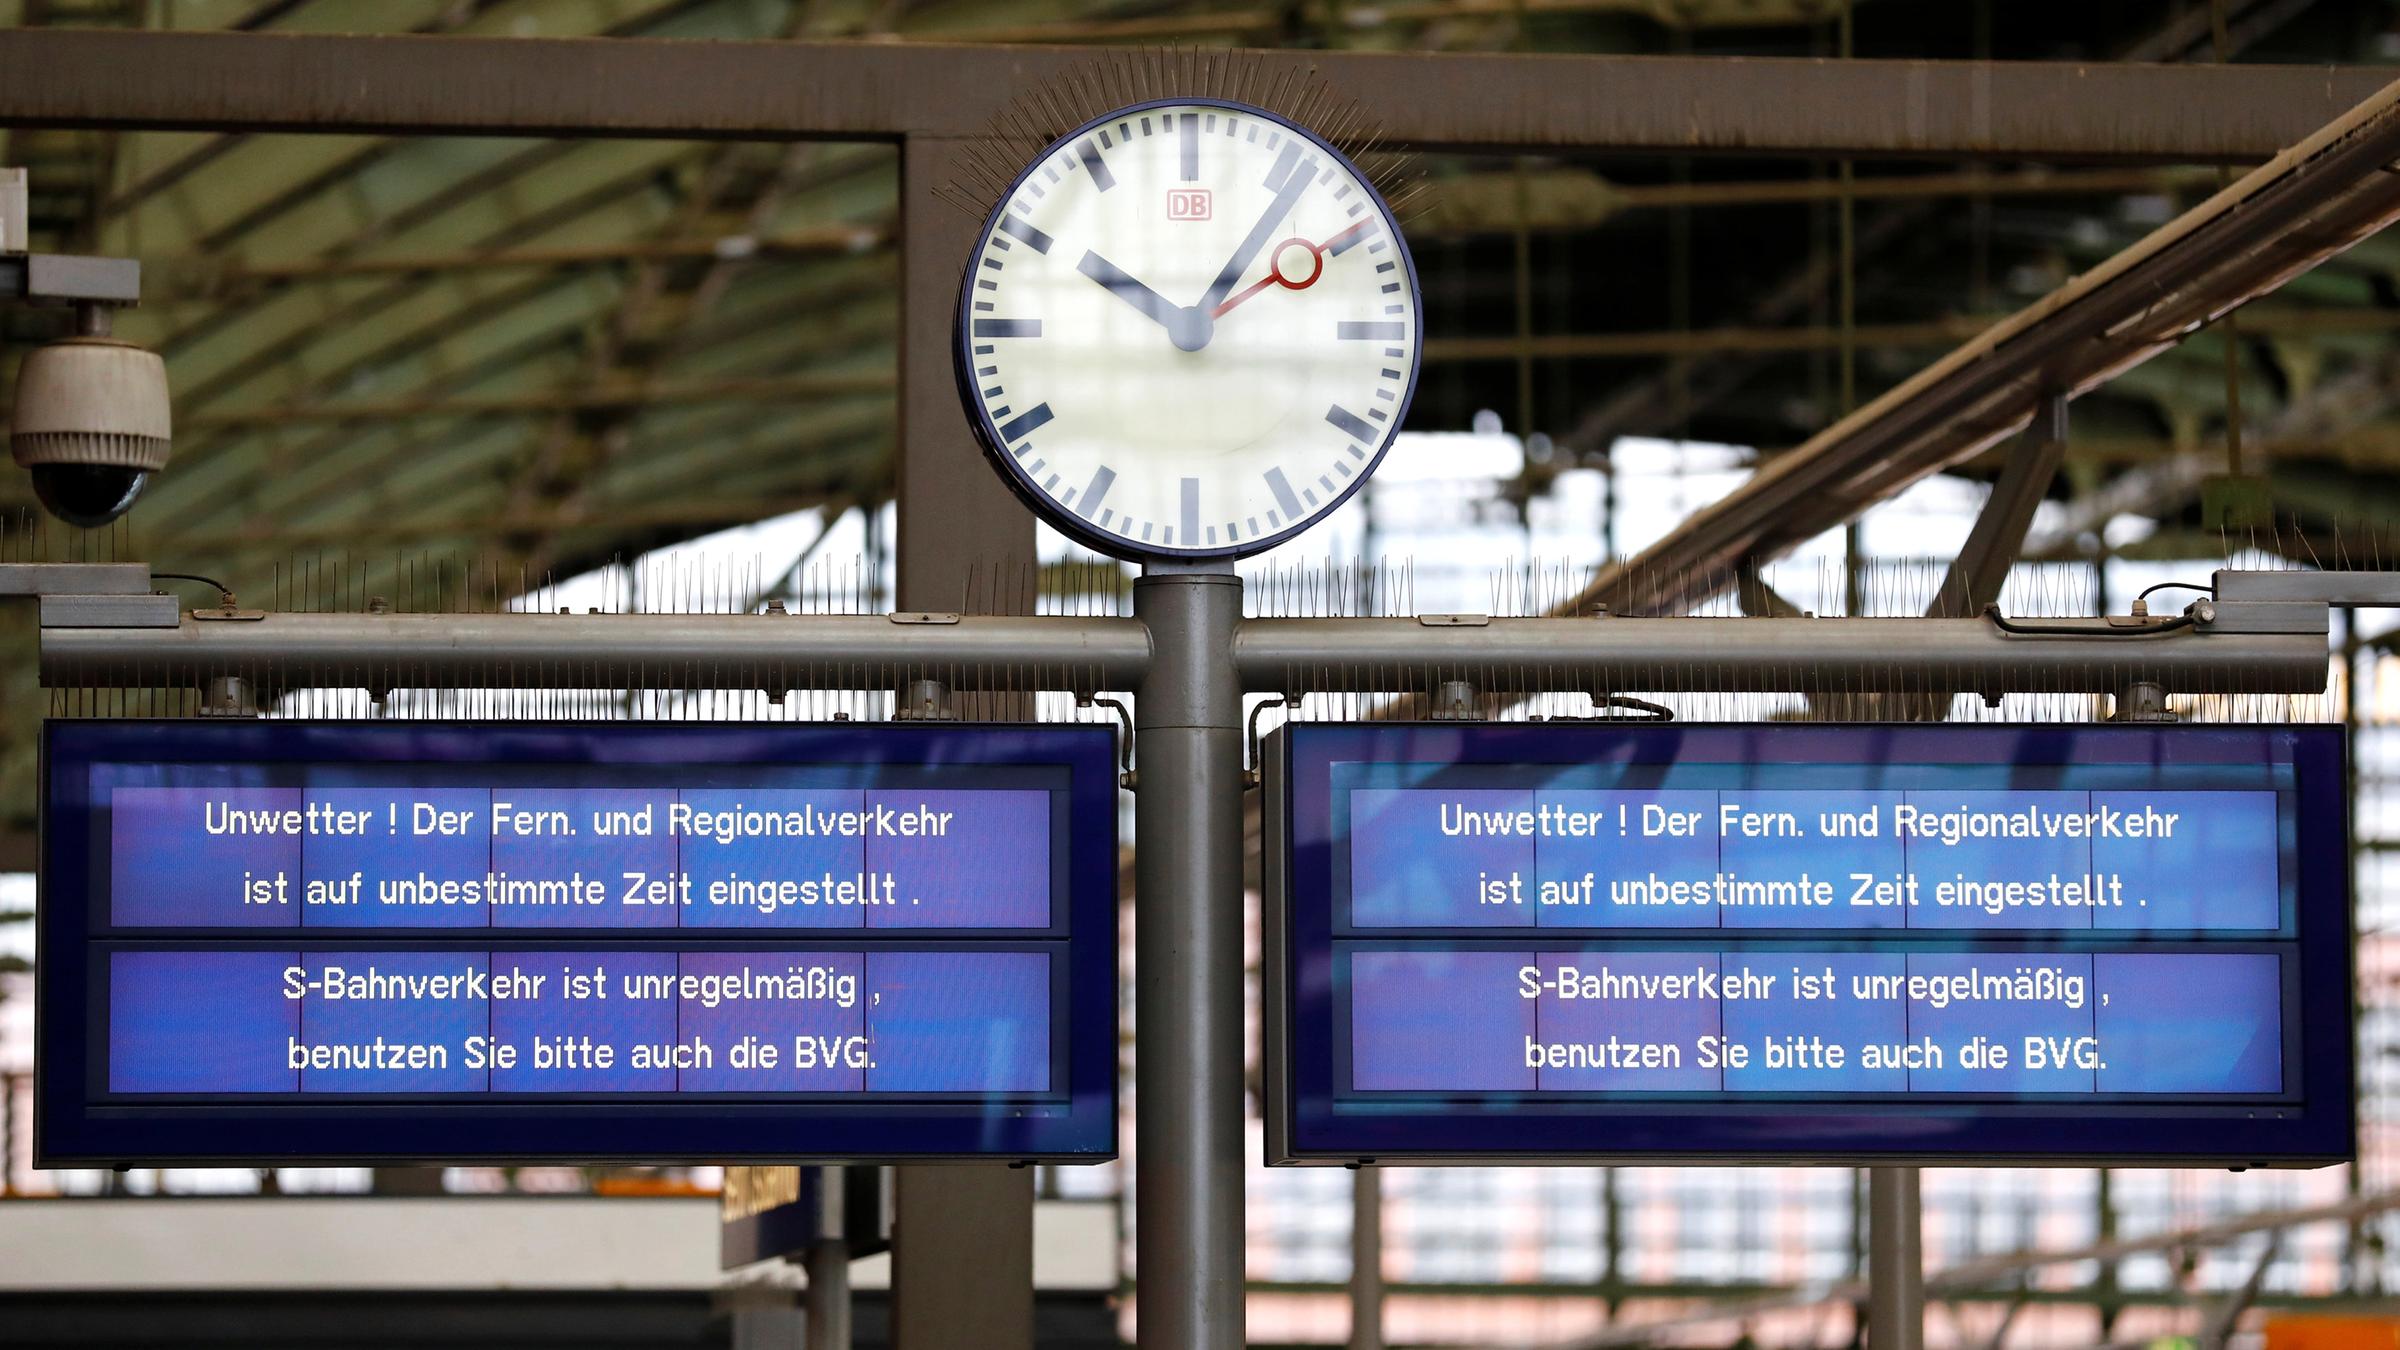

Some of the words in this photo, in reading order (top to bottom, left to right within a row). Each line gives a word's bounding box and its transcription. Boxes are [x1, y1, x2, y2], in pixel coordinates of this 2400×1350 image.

[1172, 194, 1206, 216] DB
[206, 801, 372, 835] Unwetter
[413, 802, 474, 835] Der
[492, 803, 576, 836] Fern.
[594, 803, 652, 836] und
[669, 803, 953, 844] Regionalverkehr
[1441, 803, 1603, 836] Unwetter
[1643, 804, 1702, 836] Der
[1720, 804, 1804, 837] Fern.
[1820, 805, 1878, 837] und
[1895, 804, 2179, 846] Regionalverkehr
[244, 871, 288, 904] ist
[307, 872, 362, 904] auf
[379, 872, 605, 905] unbestimmte
[622, 872, 692, 905] Zeit
[709, 872, 896, 914] eingestellt
[1480, 872, 1523, 904] ist
[1540, 872, 1594, 905] auf
[1611, 872, 1833, 906] unbestimmte
[1850, 873, 1919, 906] Zeit
[1936, 873, 2123, 915] eingestellt
[283, 966, 546, 999] S-Bahnverkehr
[564, 966, 607, 999] ist
[624, 966, 855, 1008] unregelmäßig
[1519, 966, 1776, 999] S-Bahnverkehr
[1793, 967, 1836, 1000] ist
[1853, 967, 2084, 1009] unregelmäßig
[288, 1036, 447, 1069] benutzen
[464, 1036, 517, 1069] Sie
[534, 1036, 614, 1069] bitte
[631, 1036, 712, 1069] auch
[729, 1036, 778, 1069] die
[795, 1036, 876, 1069] BVG.
[1525, 1035, 1681, 1068] benutzen
[1697, 1035, 1749, 1068] Sie
[1765, 1036, 1845, 1069] bitte
[1862, 1036, 1943, 1069] auch
[1959, 1036, 2008, 1069] die
[2024, 1036, 2106, 1069] BVG.
